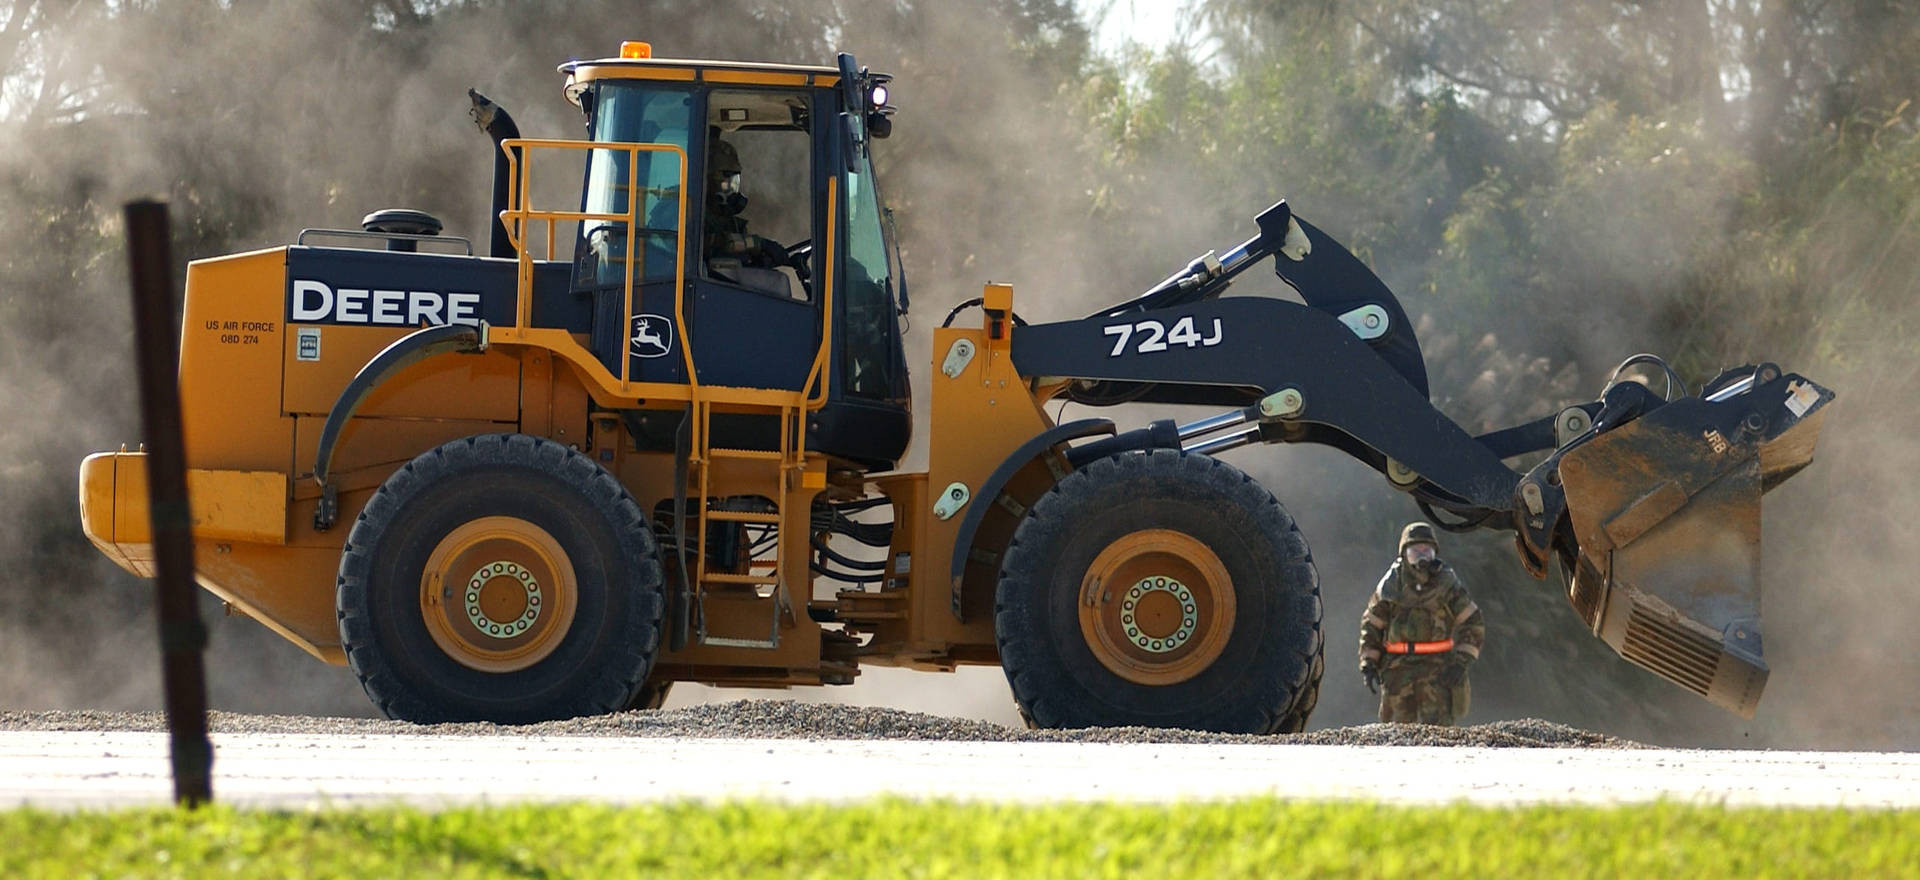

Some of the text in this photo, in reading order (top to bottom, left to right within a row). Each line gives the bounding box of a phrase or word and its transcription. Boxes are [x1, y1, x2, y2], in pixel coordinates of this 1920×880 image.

[293, 280, 480, 327] DEERE
[206, 320, 275, 333] US AIR FORCE
[1104, 317, 1222, 356] 724J
[243, 335, 259, 345] 274
[1703, 429, 1727, 453] JRB
